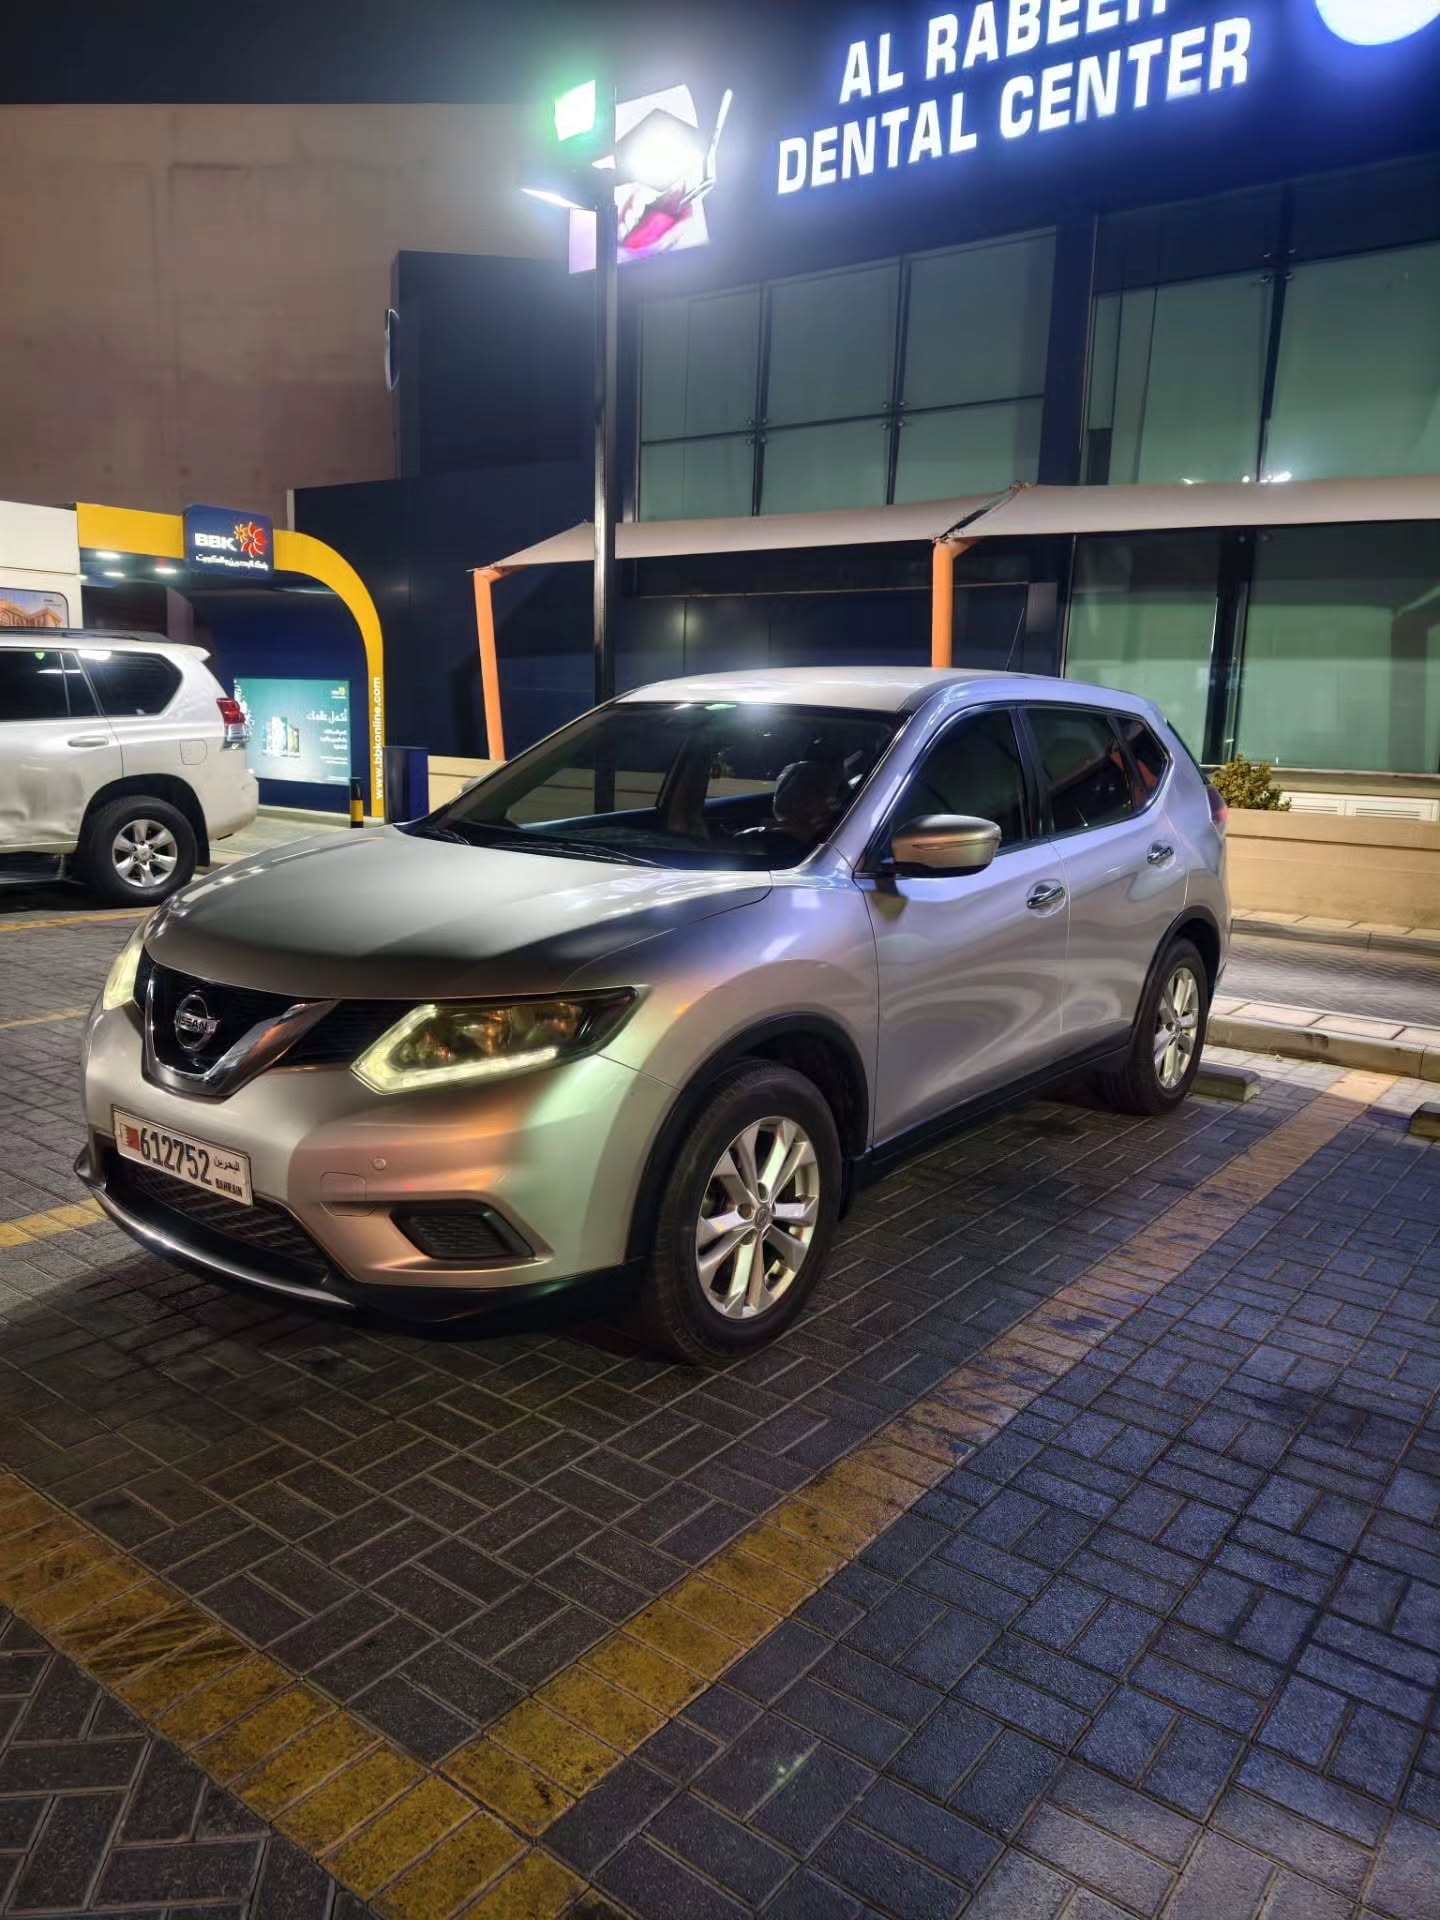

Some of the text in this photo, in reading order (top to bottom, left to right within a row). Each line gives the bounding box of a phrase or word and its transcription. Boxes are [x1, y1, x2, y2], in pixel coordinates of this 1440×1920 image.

[839, 32, 904, 103] AL
[777, 16, 1252, 195] DENTAL CENTER
[195, 533, 237, 551] BBK
[373, 676, 384, 800] www.bbkonline.com
[176, 1010, 208, 1031] NISSAN
[140, 1127, 212, 1186] 612752
[214, 1156, 240, 1174] البحرين
[215, 1178, 243, 1197] BAHRAIN
